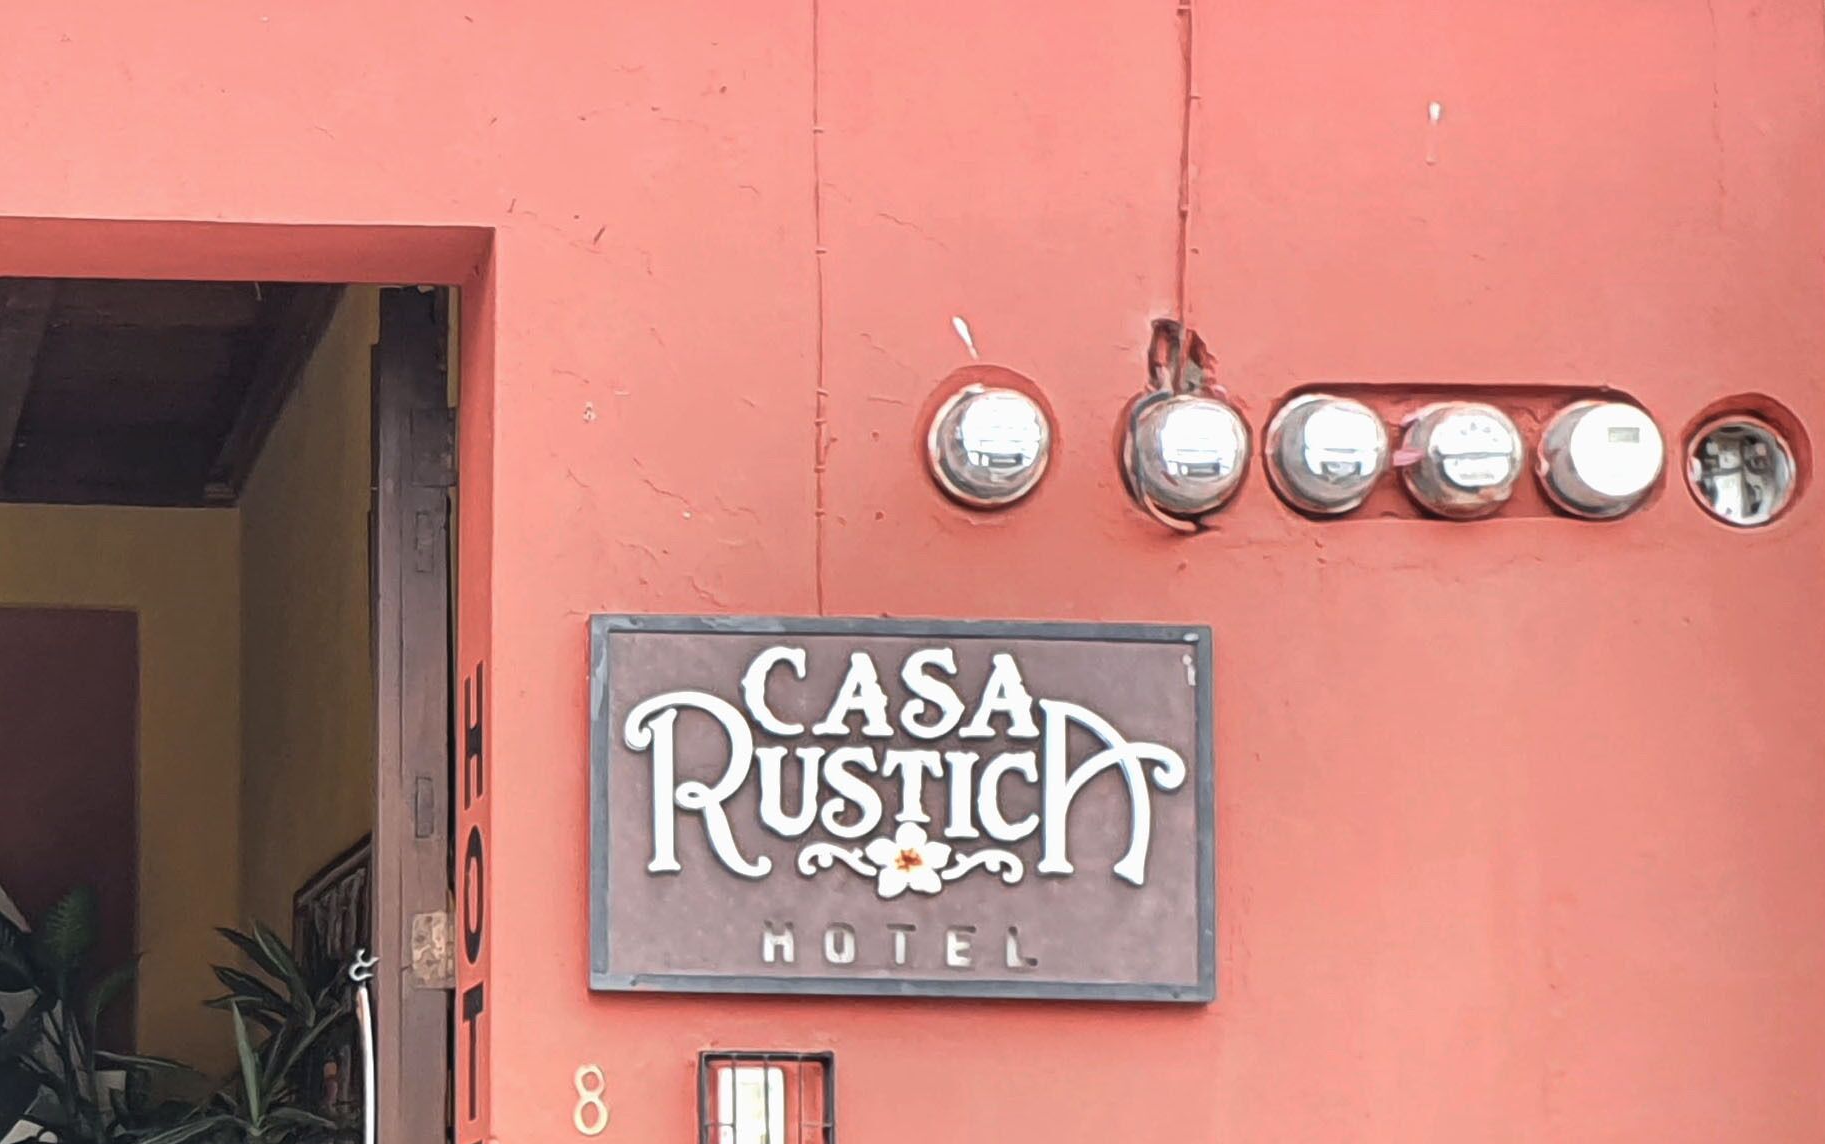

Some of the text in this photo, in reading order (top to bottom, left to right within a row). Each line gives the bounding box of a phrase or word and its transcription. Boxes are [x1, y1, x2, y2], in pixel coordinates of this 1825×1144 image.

[740, 646, 1040, 740] CASA
[625, 691, 1187, 886] RUSTICA
[761, 919, 1040, 969] HOTEL
[572, 1063, 610, 1137] 8
